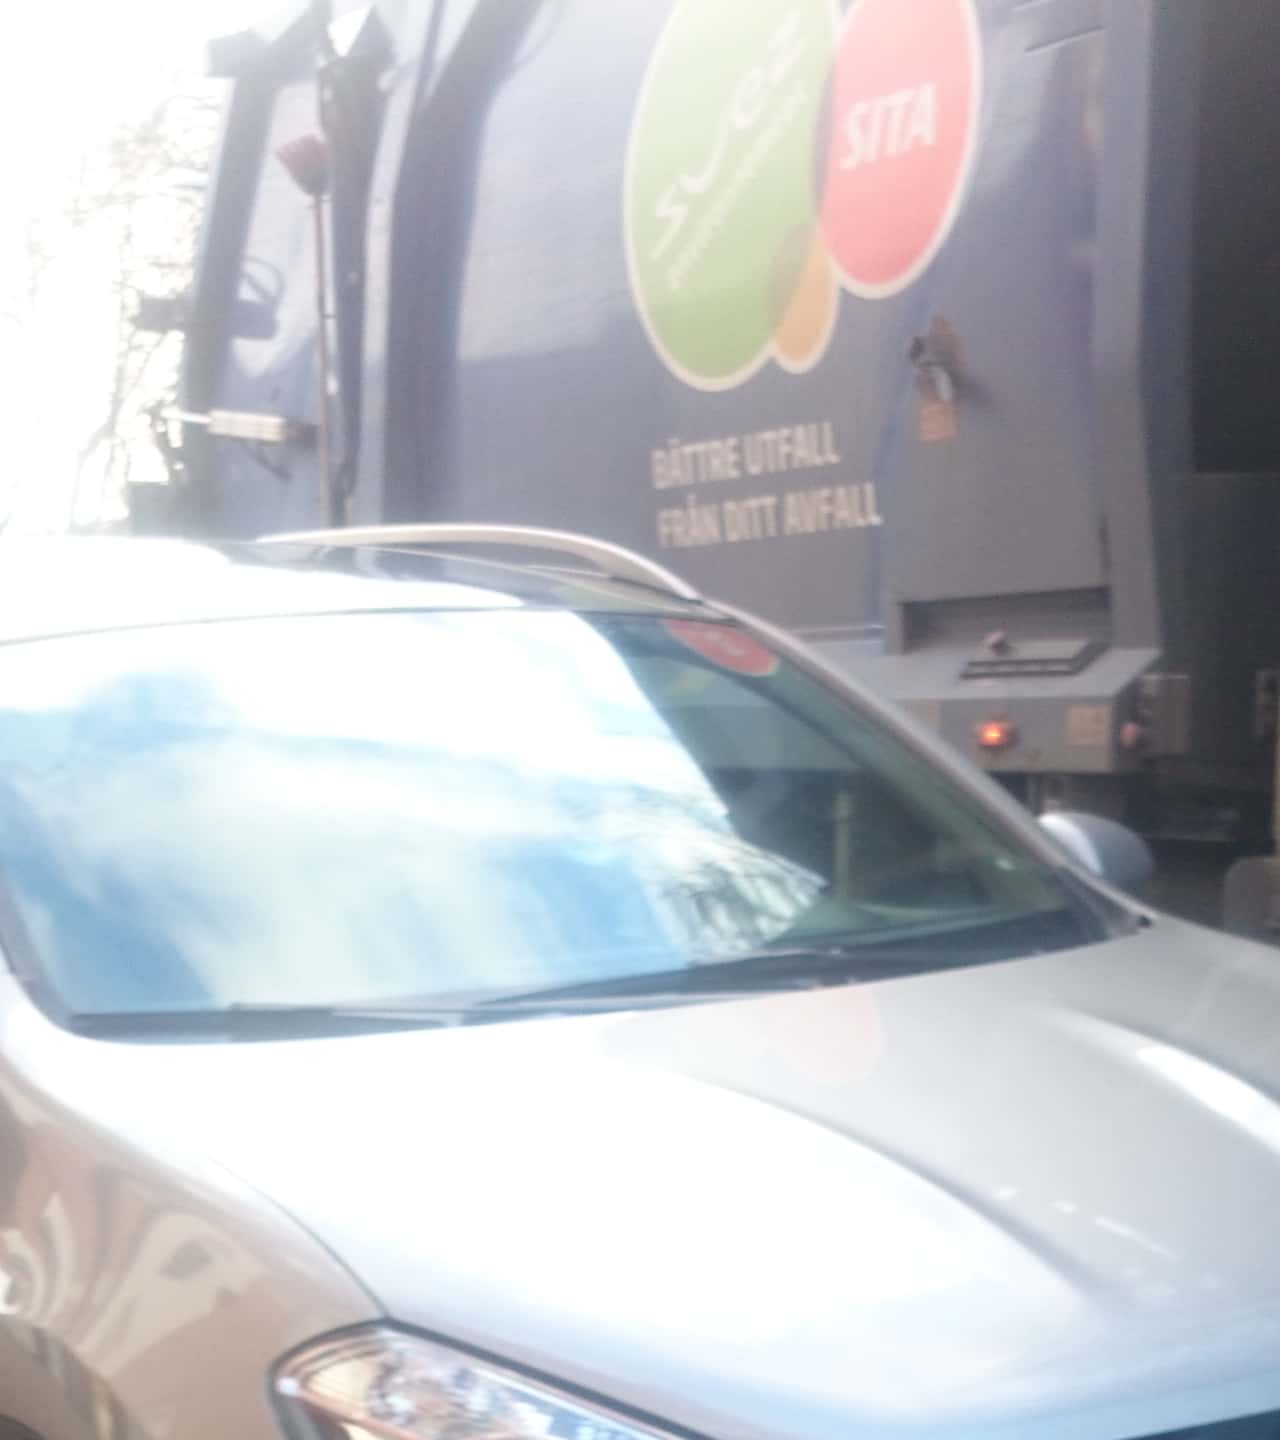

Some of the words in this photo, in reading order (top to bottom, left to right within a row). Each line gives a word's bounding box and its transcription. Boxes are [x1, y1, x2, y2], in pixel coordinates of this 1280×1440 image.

[839, 83, 938, 171] SITA
[743, 420, 840, 476] UTFALL
[656, 493, 721, 549] FRÅN
[784, 482, 883, 536] AVFALL
